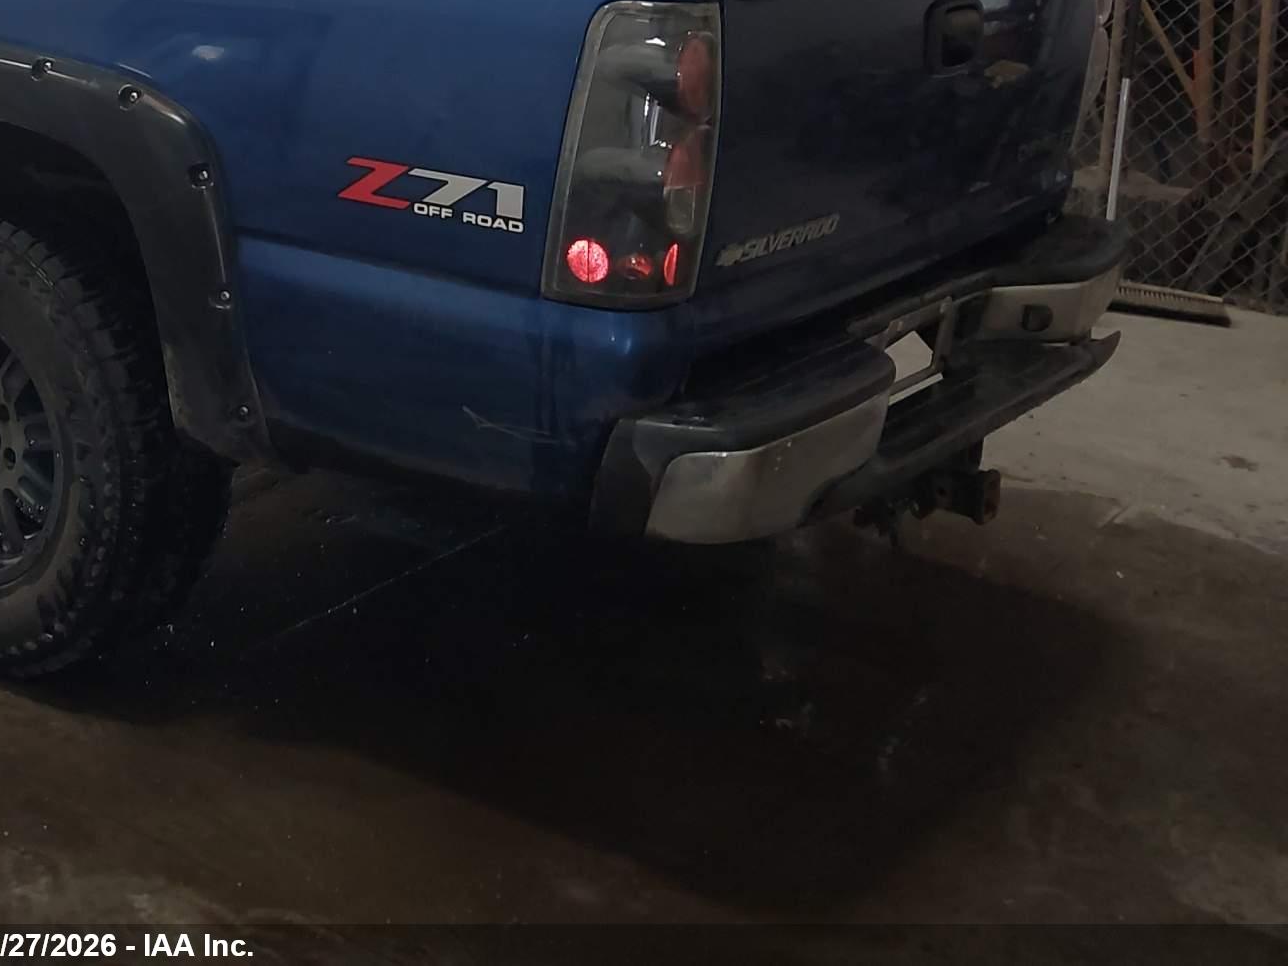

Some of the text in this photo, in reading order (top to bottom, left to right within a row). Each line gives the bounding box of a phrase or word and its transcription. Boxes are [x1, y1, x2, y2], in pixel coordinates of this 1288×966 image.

[337, 157, 525, 219] Z71
[413, 203, 524, 233] OFF ROAD
[740, 212, 840, 263] SILVERADO
